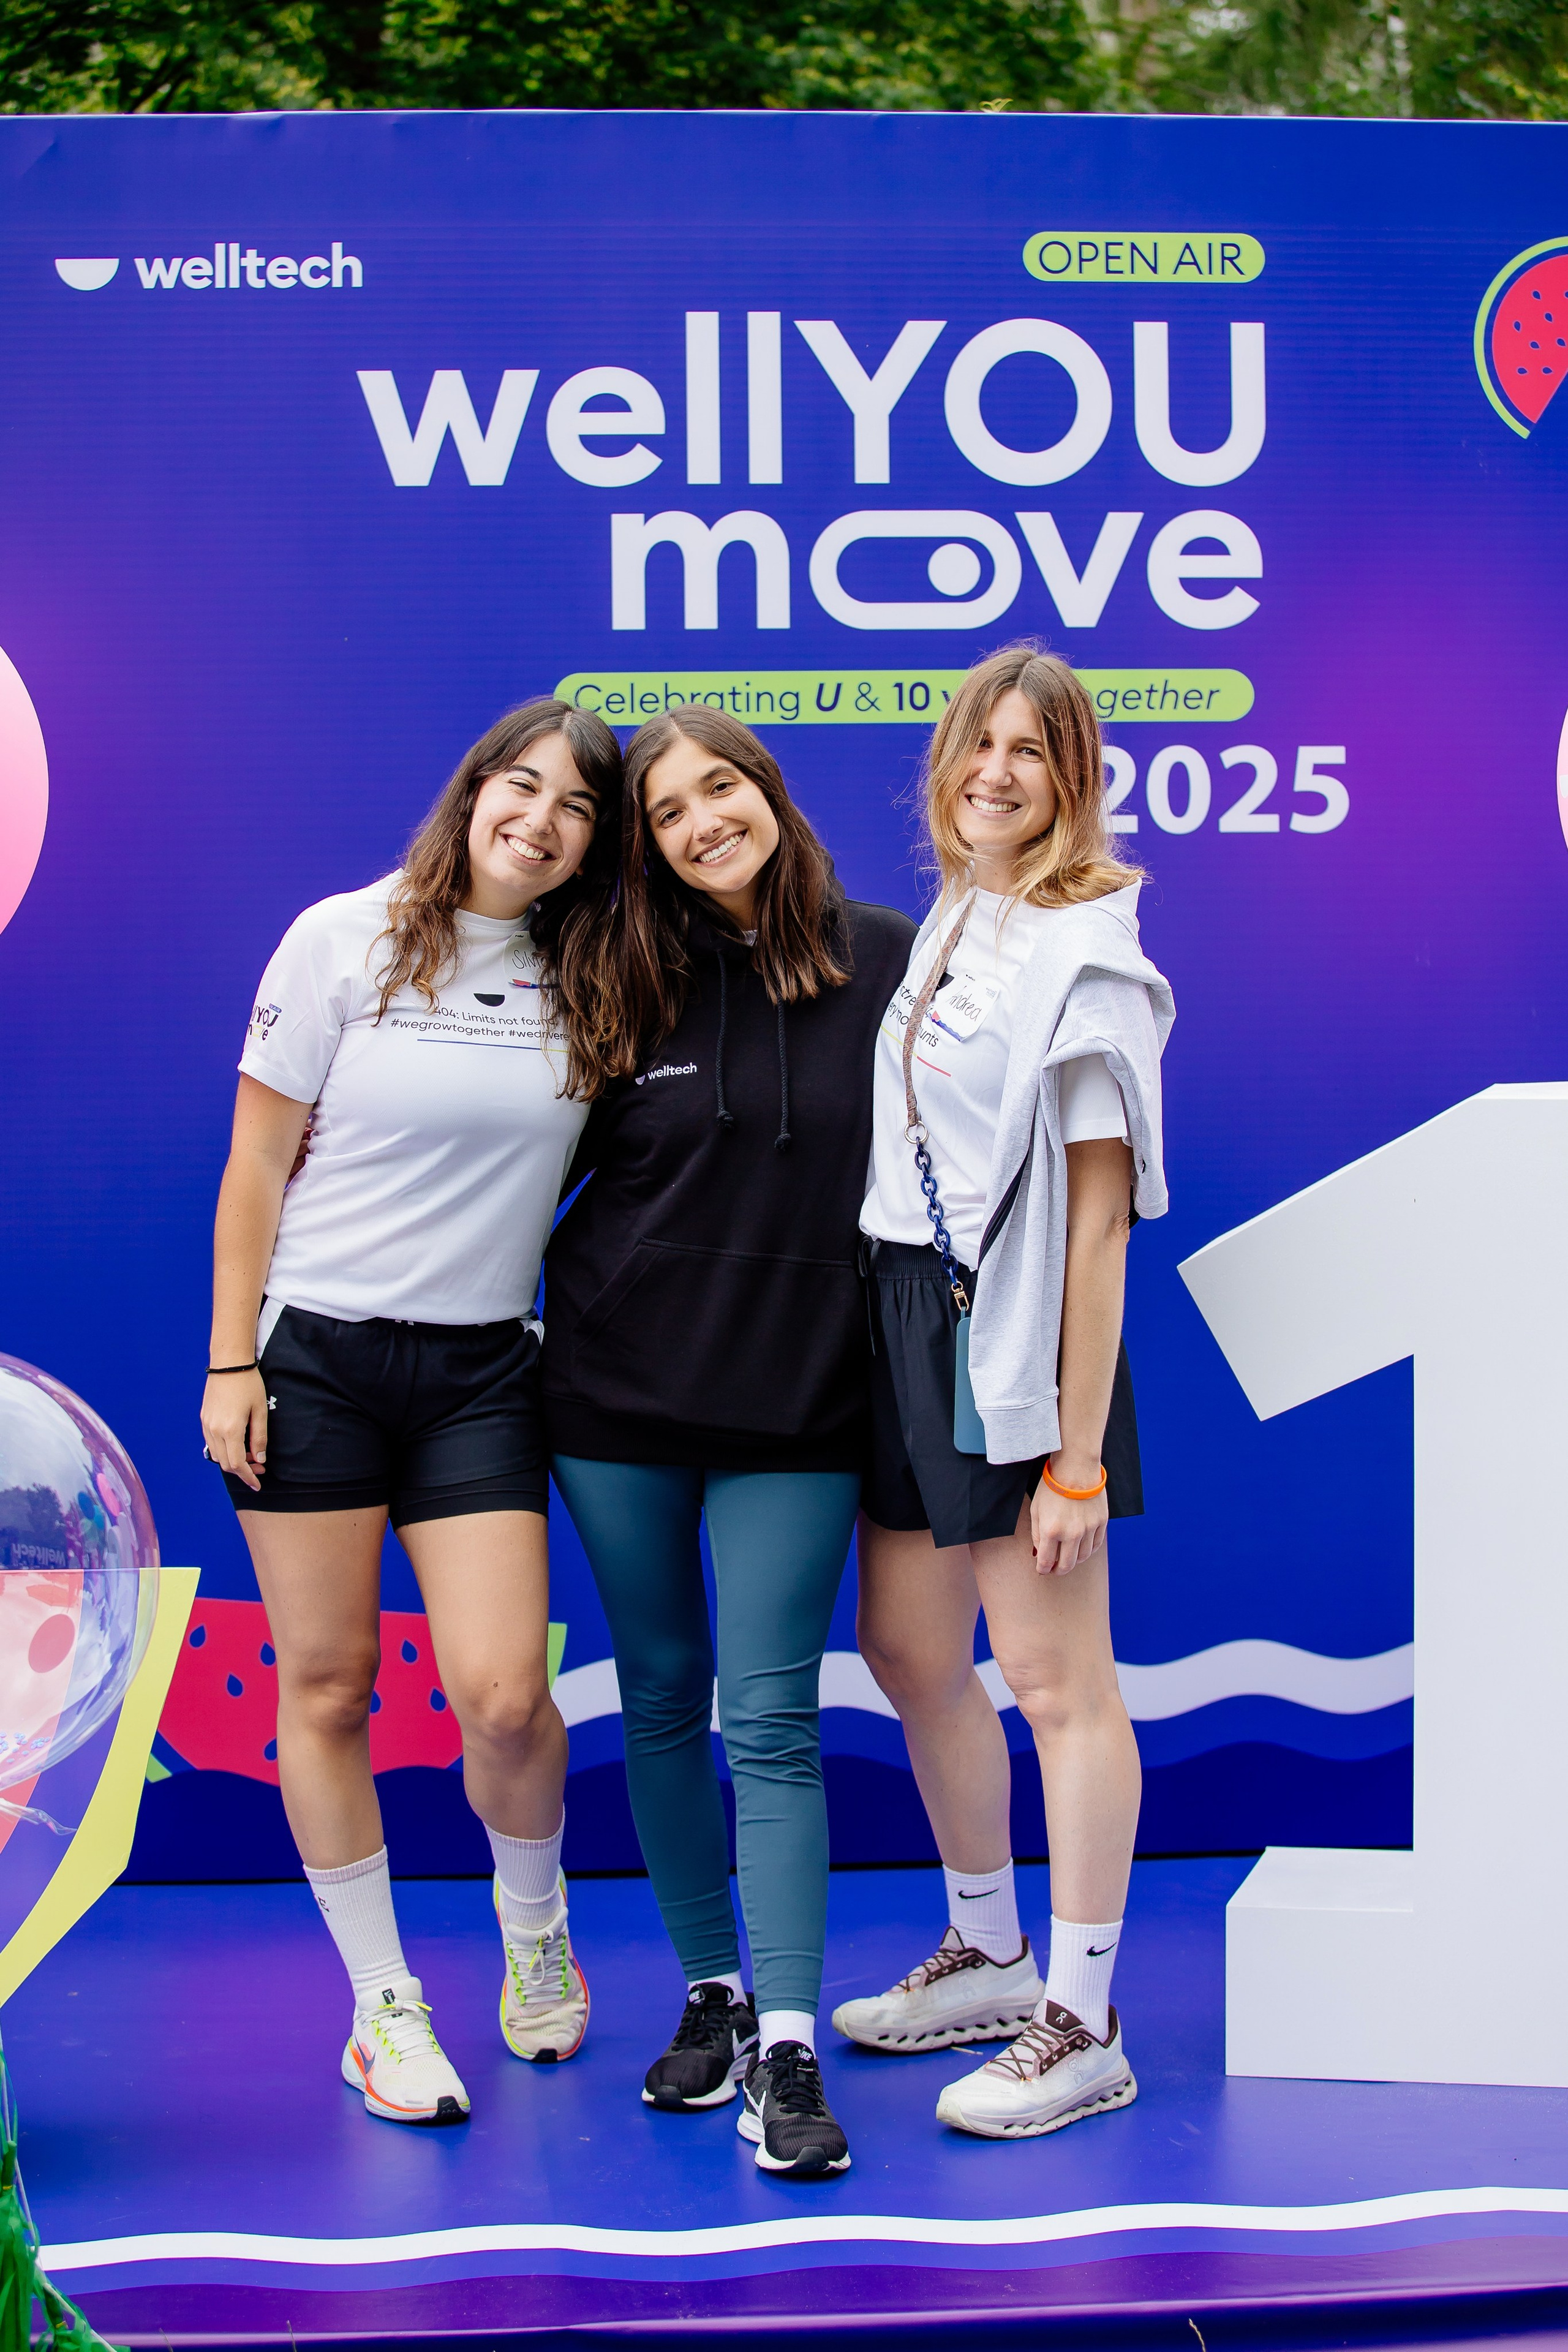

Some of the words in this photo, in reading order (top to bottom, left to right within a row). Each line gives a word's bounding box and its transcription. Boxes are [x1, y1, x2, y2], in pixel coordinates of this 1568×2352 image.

[134, 242, 363, 289] welltech
[1039, 241, 1158, 274] OPEN
[1173, 242, 1245, 276] AIR
[357, 311, 1266, 488] wellYOU
[612, 510, 1264, 631] move
[816, 683, 842, 712] U
[855, 682, 881, 712] &
[893, 682, 930, 711] 10
[1091, 680, 1221, 718] gether
[1101, 745, 1350, 835] 2025
[391, 1018, 505, 1037] #wegrowtogether
[508, 1030, 570, 1041] #wedrivere
[462, 1011, 496, 1024] Limits
[499, 1015, 519, 1025] not
[647, 1062, 697, 1080] welltech
